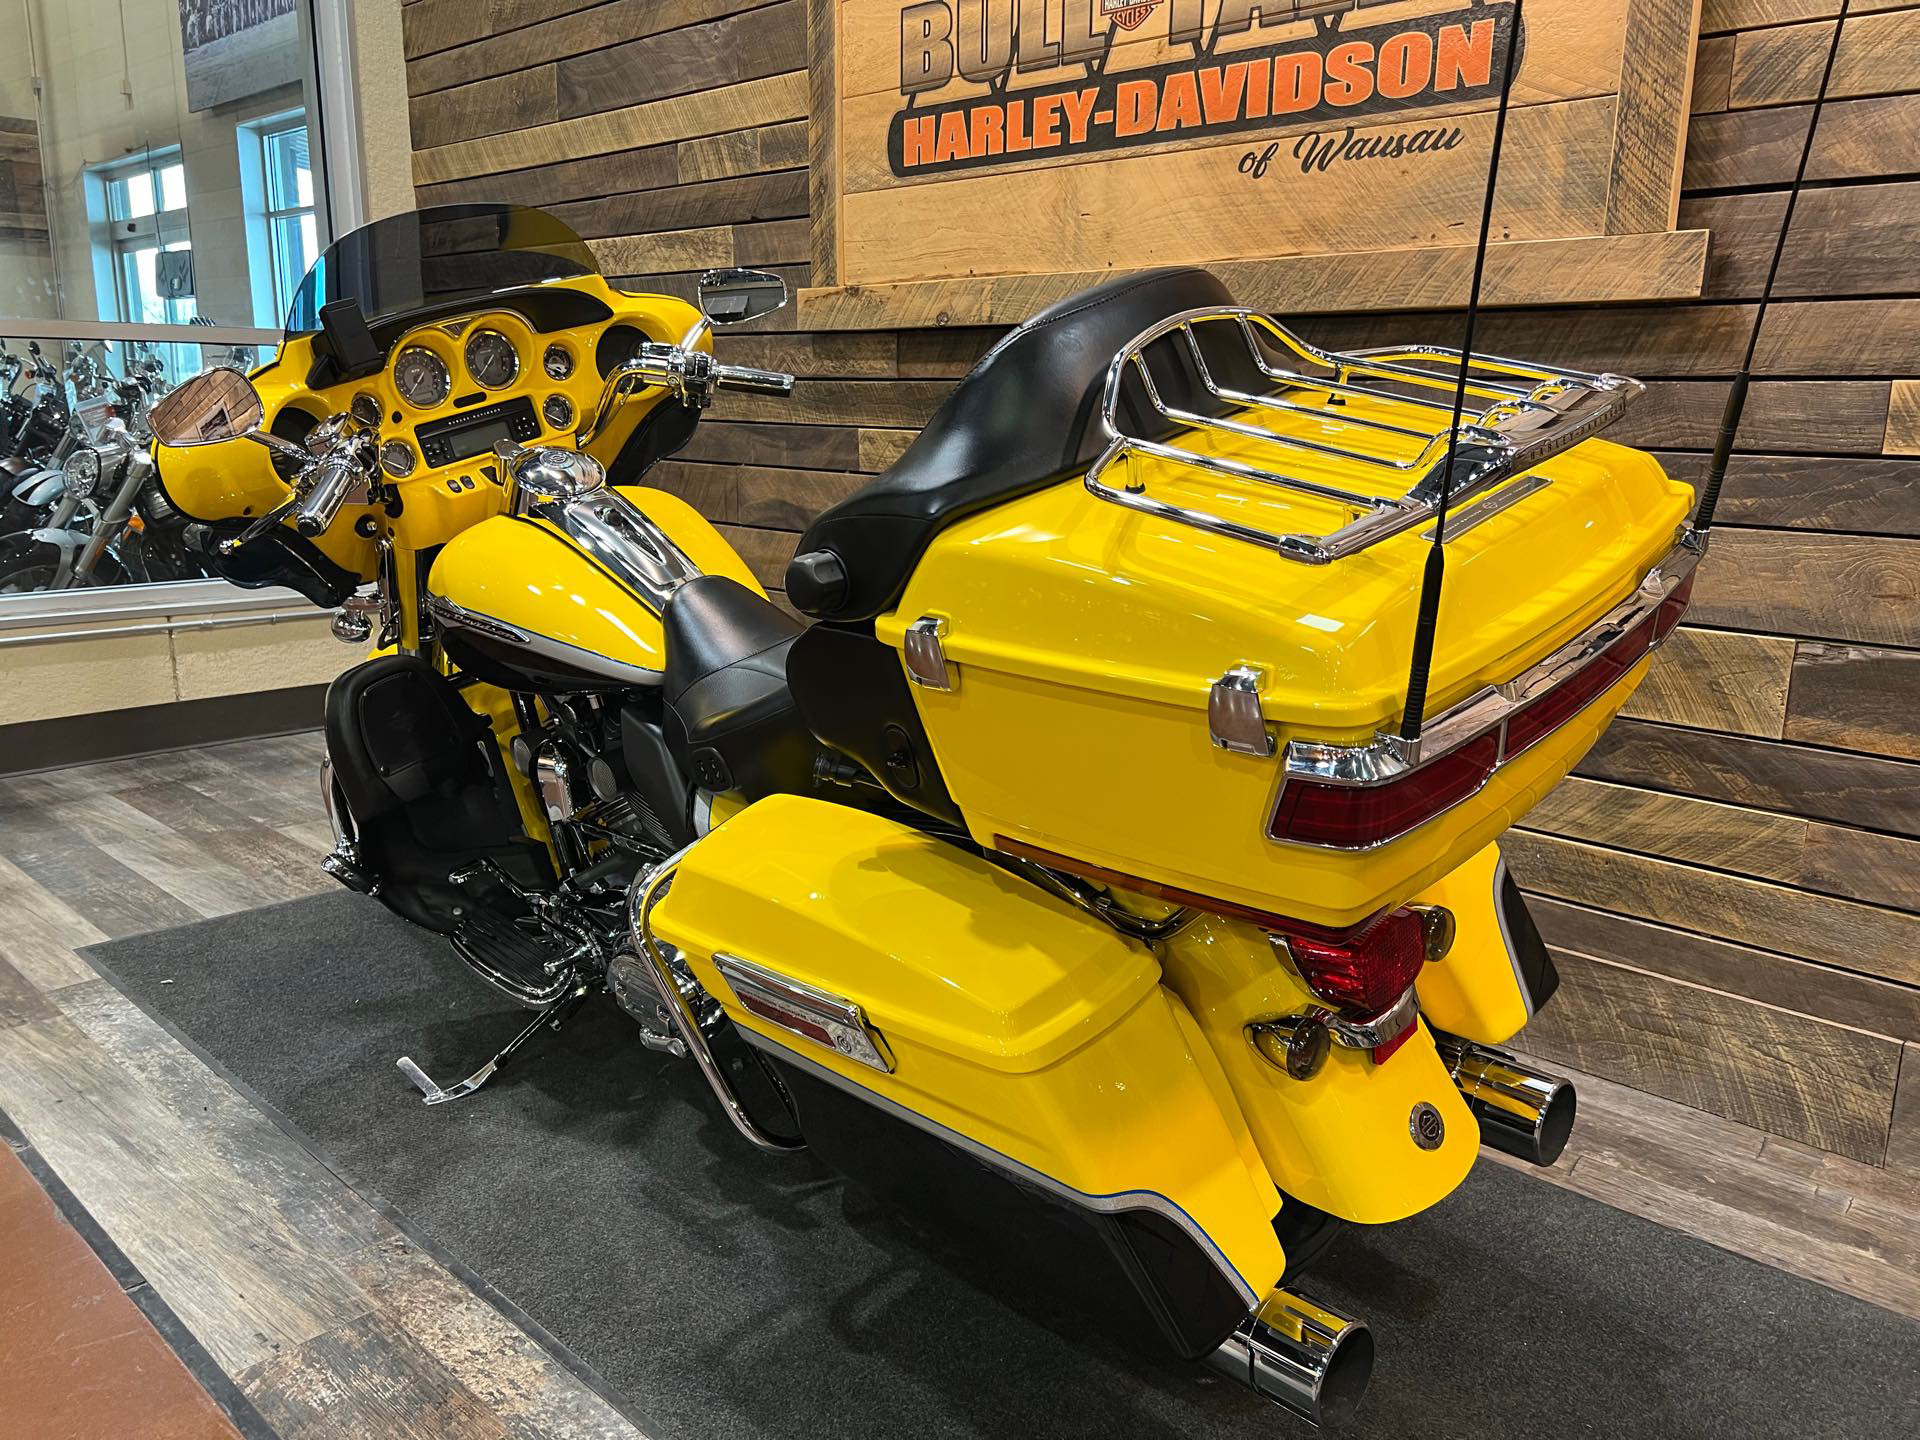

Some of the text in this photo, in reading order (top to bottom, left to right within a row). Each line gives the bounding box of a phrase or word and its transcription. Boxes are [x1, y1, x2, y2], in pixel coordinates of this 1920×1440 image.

[1116, 6, 1147, 26] CYCLES
[903, 18, 1495, 167] HARLEY-DAVIDSON
[1238, 126, 1465, 180] of Wausau
